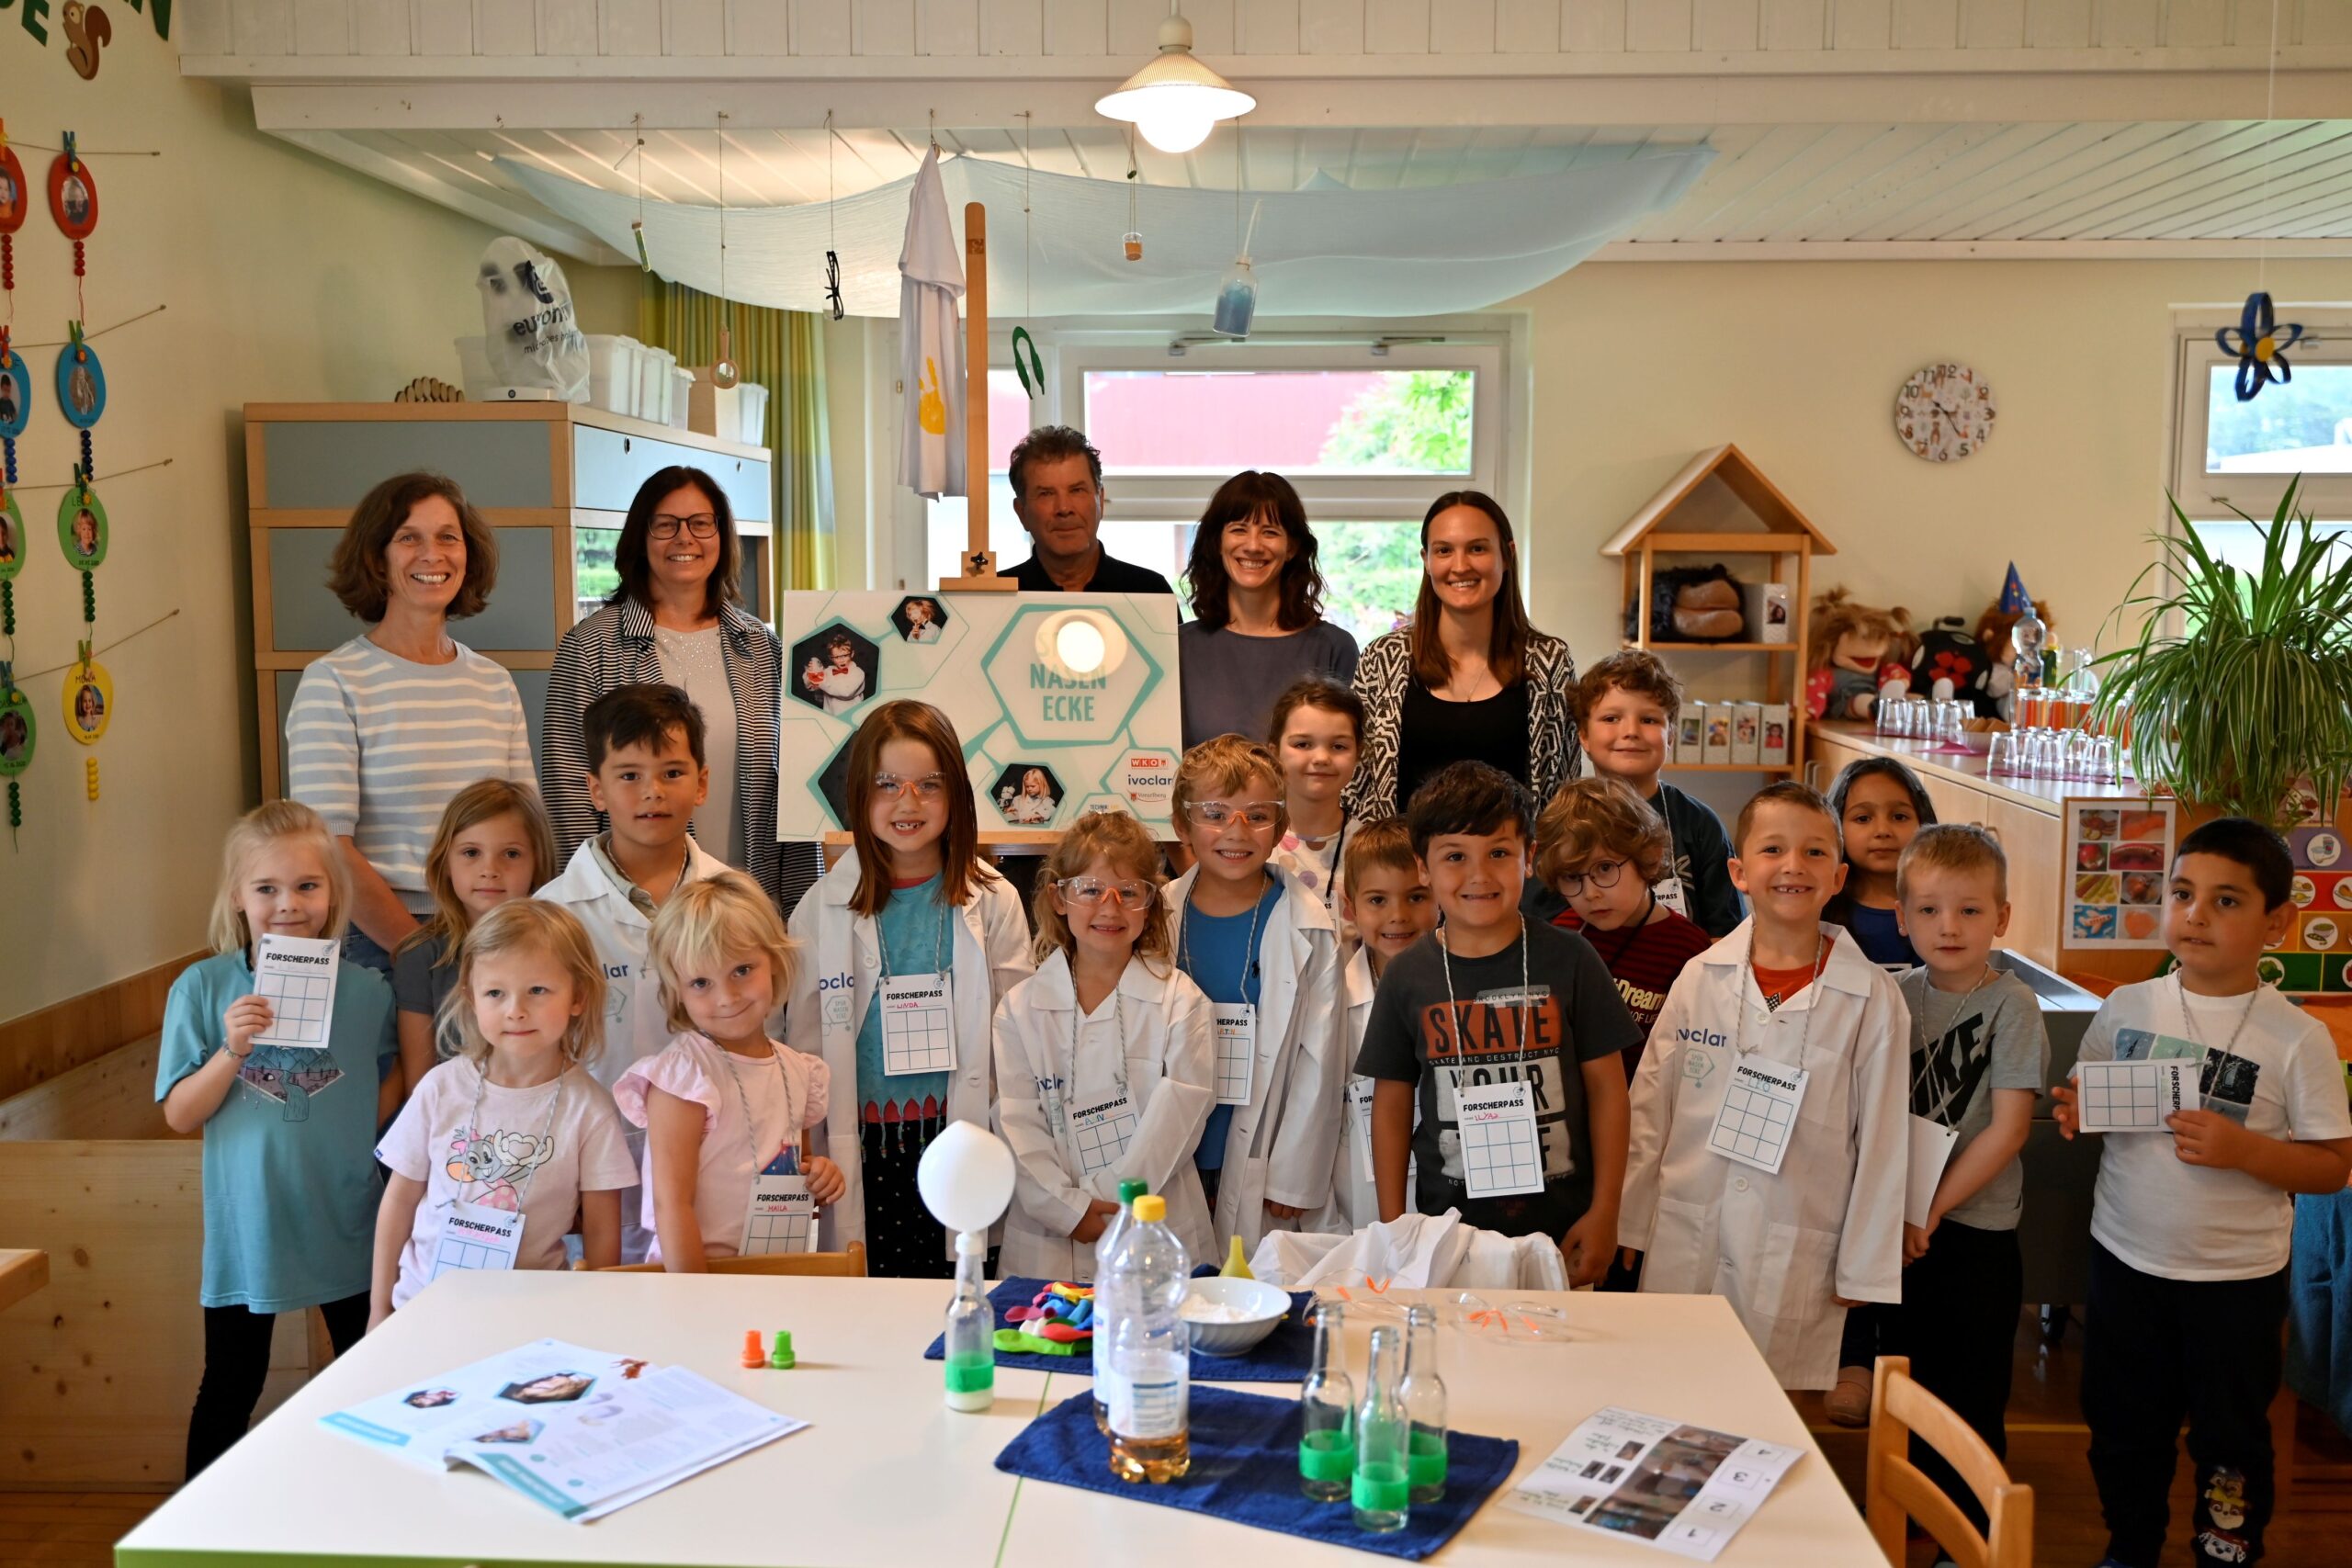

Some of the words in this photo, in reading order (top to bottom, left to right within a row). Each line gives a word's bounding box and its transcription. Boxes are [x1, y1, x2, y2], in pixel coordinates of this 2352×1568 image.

[1905, 384, 1919, 400] 10
[1984, 407, 1996, 422] 3
[1975, 428, 1985, 443] 4
[1939, 447, 1949, 461] 6
[1958, 443, 1970, 457] 5
[1030, 662, 1107, 690] NASEN
[1043, 695, 1095, 722] ECKE
[1131, 758, 1159, 768] WKO
[1127, 773, 1172, 786] ivoclar
[266, 952, 331, 966] FORSCHERPASS
[603, 963, 628, 980] lar
[886, 989, 944, 1001] FORSCHERPASS
[1216, 1018, 1249, 1027] HERPASS
[1430, 998, 1551, 1054] SKATE
[1462, 1055, 1480, 1064] AND
[1487, 1050, 1539, 1062] DESTRUCT
[1736, 1066, 1797, 1092] FORSCHERPASS
[2169, 1065, 2181, 1112] FORSCHERP
[1072, 1097, 1128, 1120] FORSCHERPASS
[1463, 1099, 1525, 1112] FORSCHERPASS
[756, 1193, 809, 1202] FORSCHERPASS
[448, 1216, 513, 1238] FORSCHERPASS
[1733, 1472, 1748, 1483] 3
